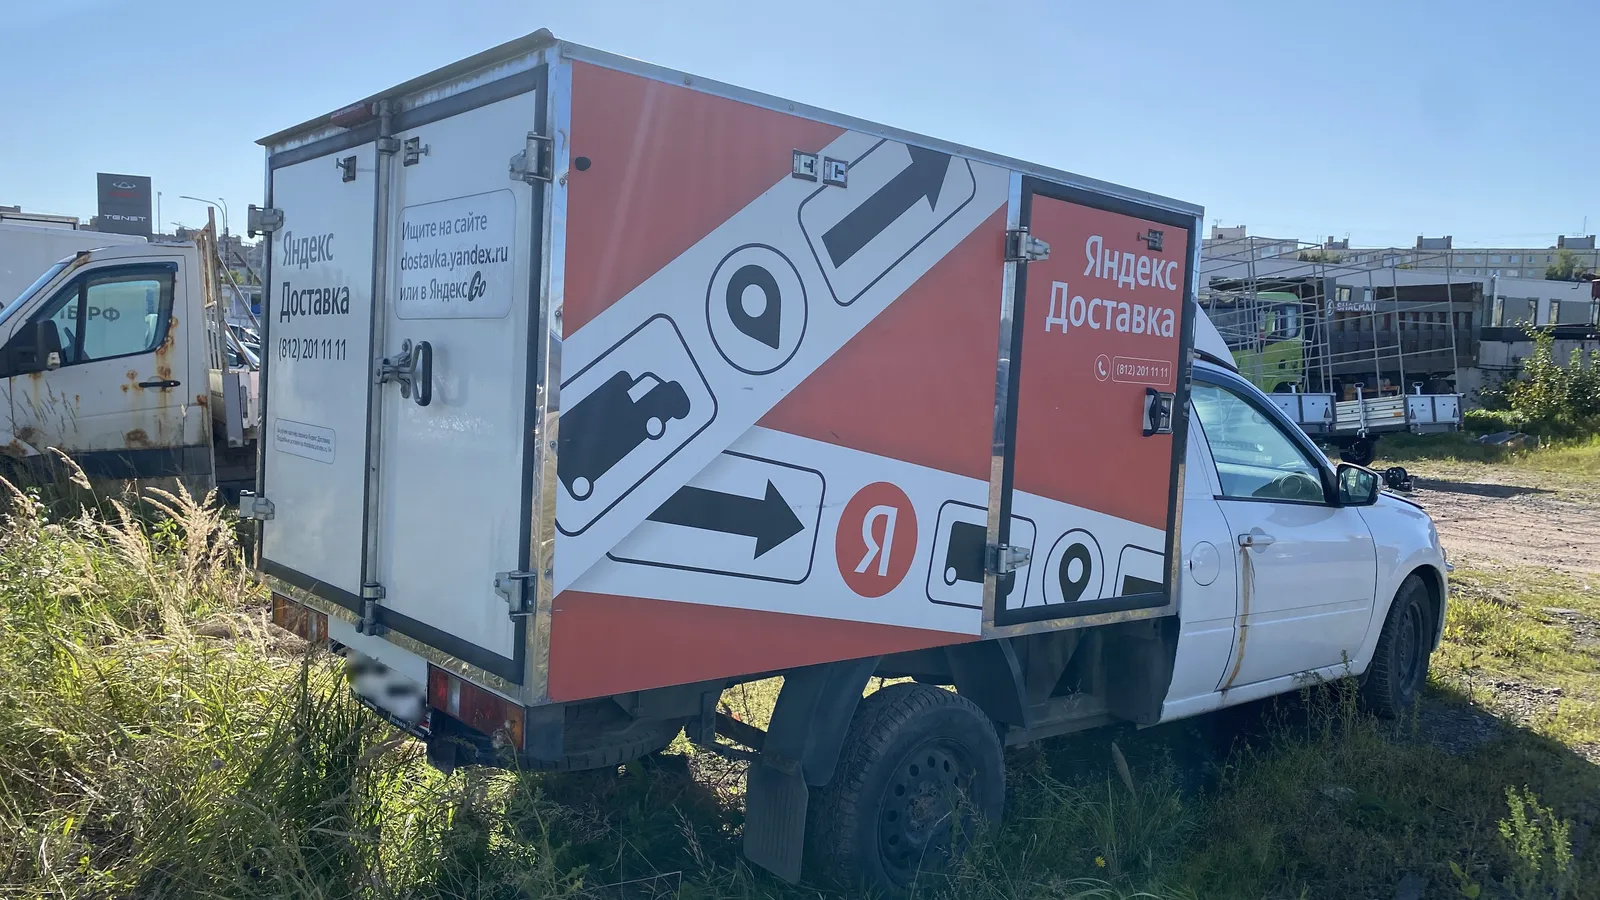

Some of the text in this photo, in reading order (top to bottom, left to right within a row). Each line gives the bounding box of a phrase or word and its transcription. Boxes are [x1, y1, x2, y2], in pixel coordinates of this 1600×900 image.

[104, 214, 147, 222] TENET
[402, 211, 488, 242] Ищите на сайте
[283, 231, 334, 270] Яндекс
[401, 244, 508, 271] dostavka.yandex.ru
[1084, 235, 1178, 291] Яндекс
[280, 281, 349, 323] Доставка
[400, 270, 487, 302] или в Яндекс Go
[1045, 280, 1175, 338] Доставка
[278, 337, 346, 362] (812) 201 11 11
[1116, 363, 1168, 378] (812) 201 11 11
[853, 504, 898, 577] Я
